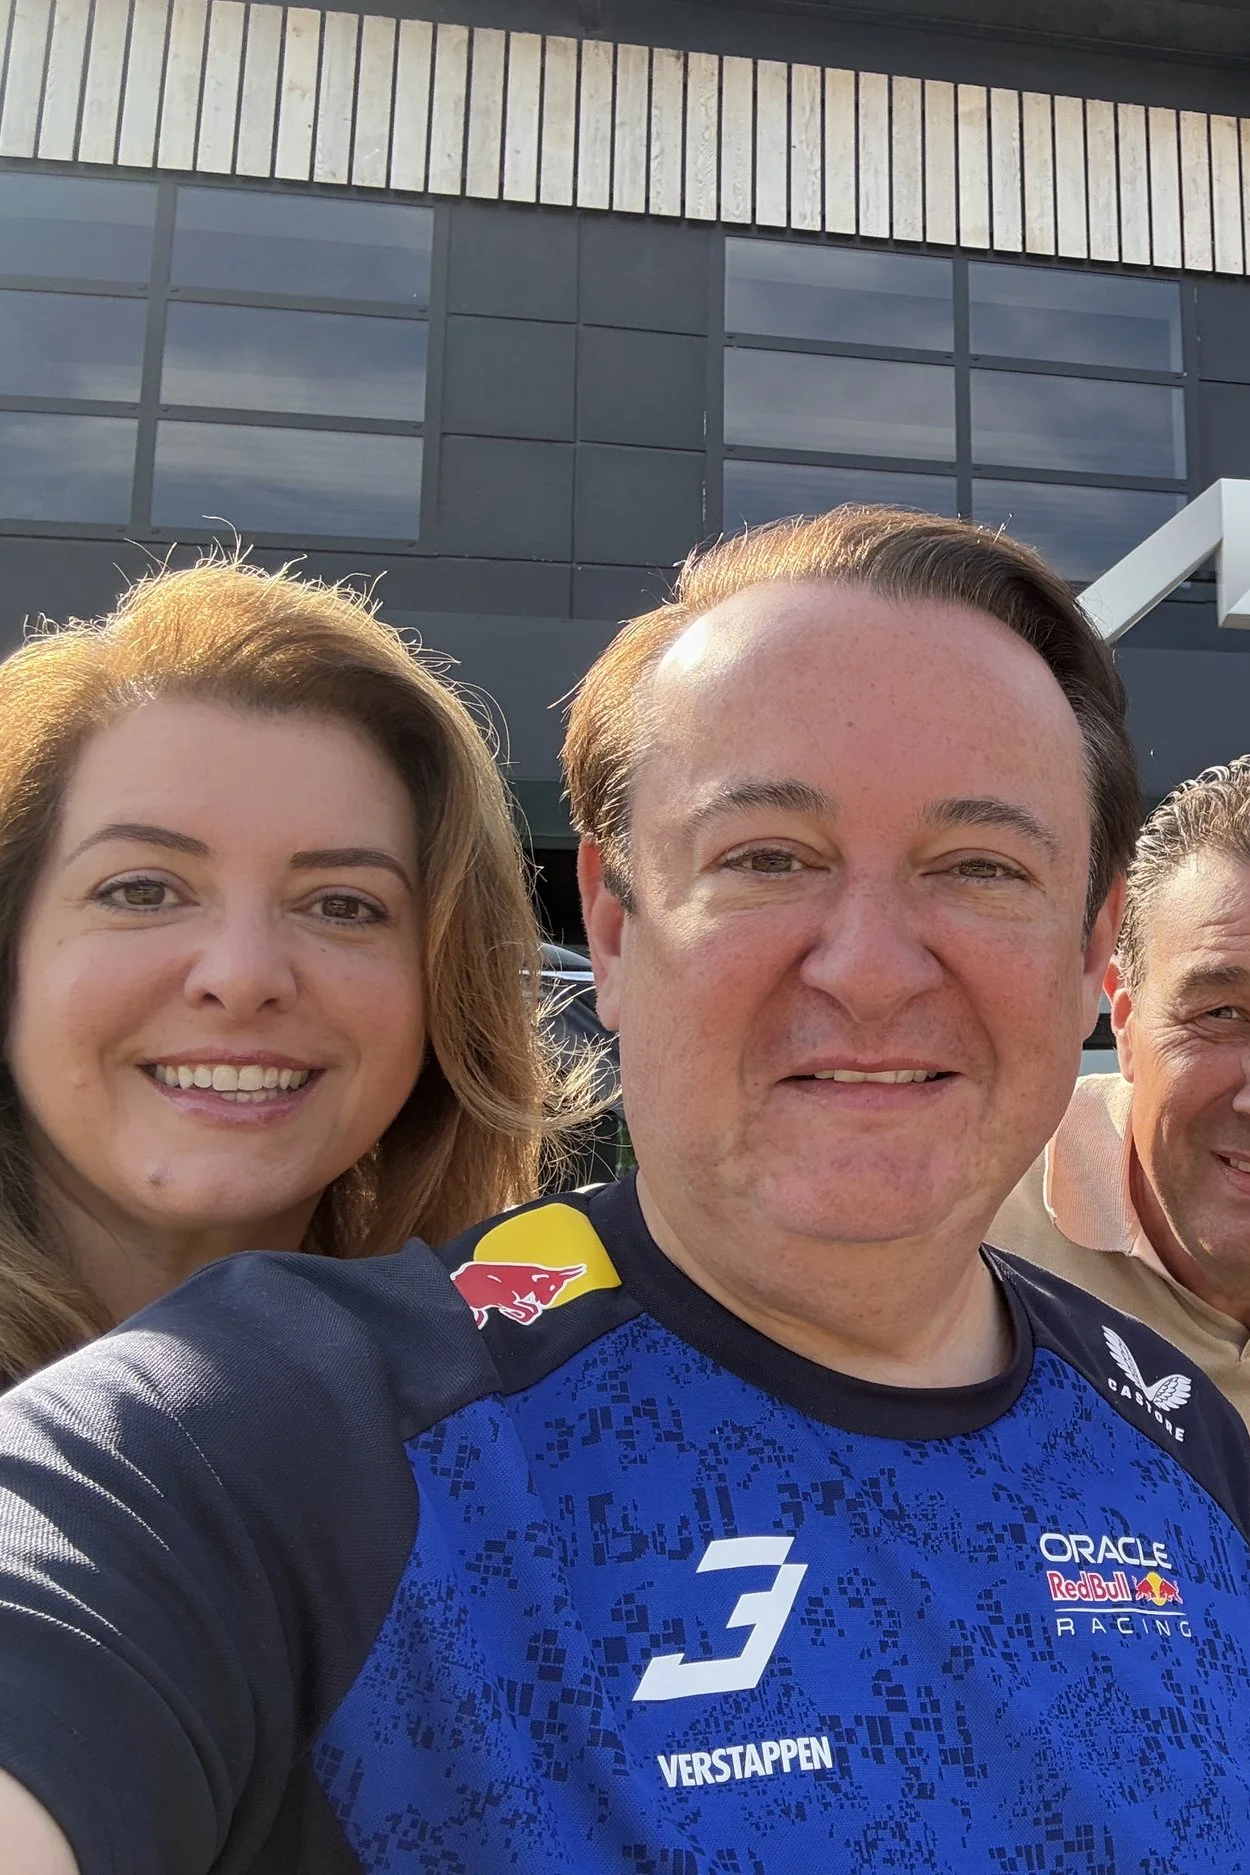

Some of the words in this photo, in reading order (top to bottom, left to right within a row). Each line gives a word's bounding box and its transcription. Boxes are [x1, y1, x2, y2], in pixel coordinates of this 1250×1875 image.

[1108, 1378, 1185, 1442] CASTORE
[1039, 1532, 1172, 1569] ORACLE
[632, 1536, 808, 1701] 3
[1056, 1617, 1192, 1637] RACING
[657, 1736, 833, 1788] VERSTAPPEN
